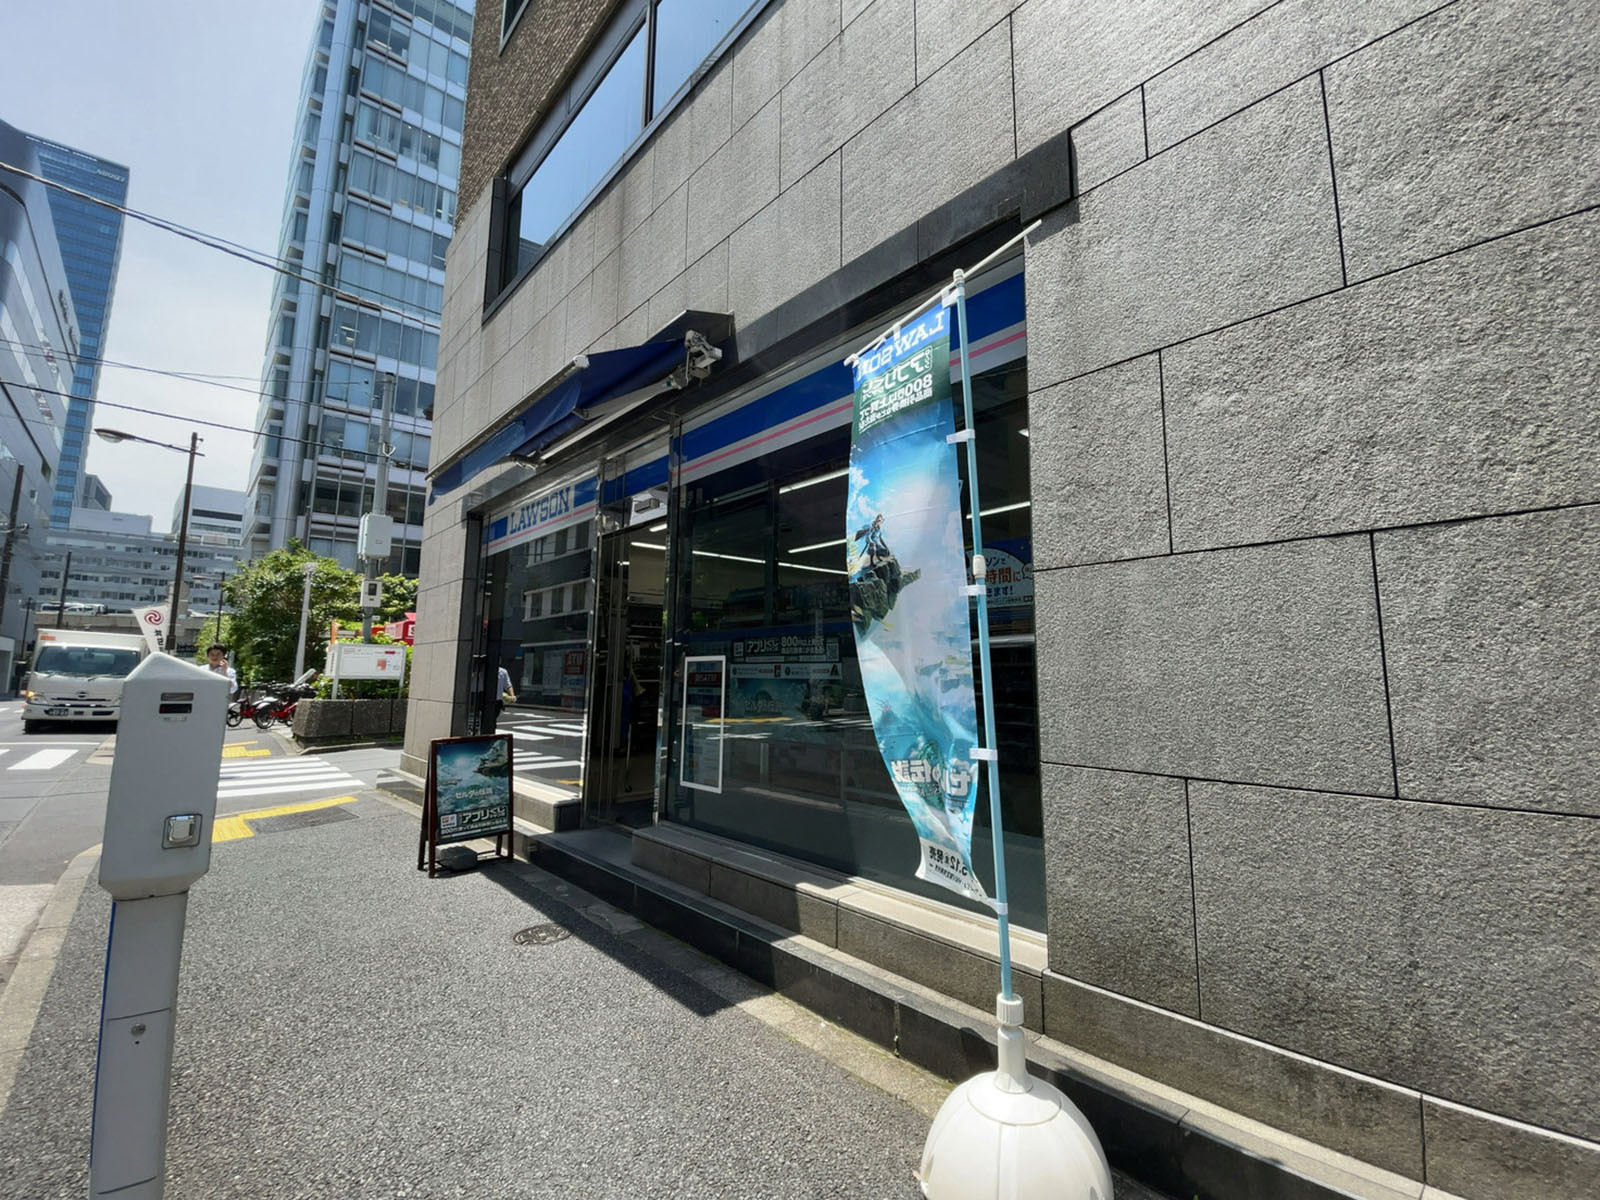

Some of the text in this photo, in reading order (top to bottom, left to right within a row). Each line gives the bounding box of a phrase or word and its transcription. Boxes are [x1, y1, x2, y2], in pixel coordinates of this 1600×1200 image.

[510, 486, 571, 535] LAWSON
[462, 806, 506, 824] アプリくじ
